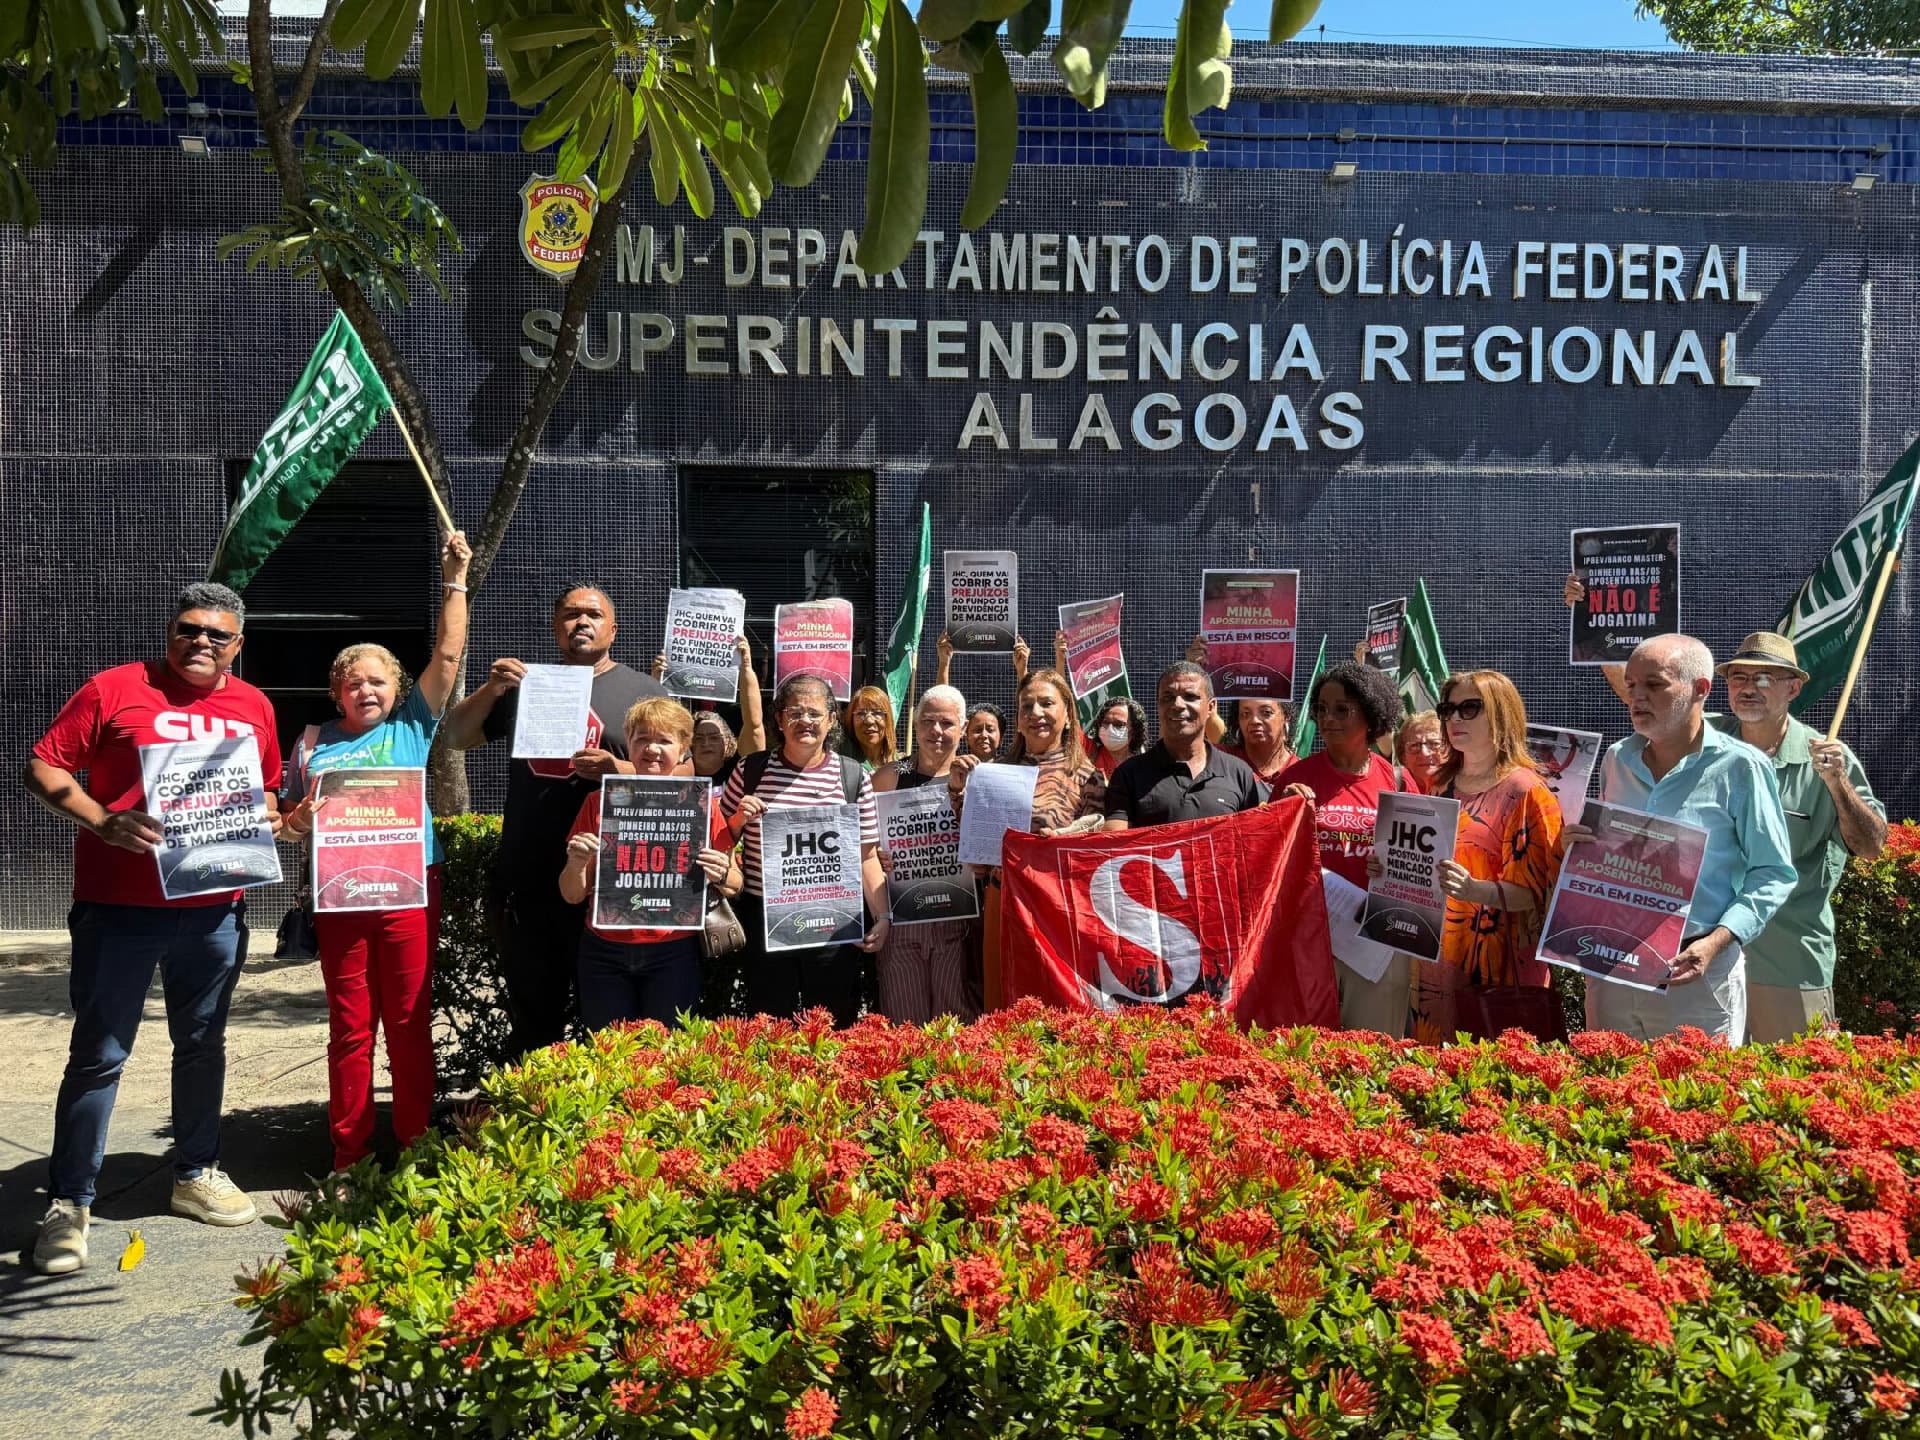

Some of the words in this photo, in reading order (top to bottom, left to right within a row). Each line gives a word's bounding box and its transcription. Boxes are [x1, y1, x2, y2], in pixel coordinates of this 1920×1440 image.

[533, 245, 584, 261] FEDERAL
[724, 226, 1171, 295] DEPATAMENTO
[1190, 236, 1258, 294] DE
[1280, 223, 1492, 298] POLÍCIA
[1514, 240, 1762, 302] FEDERAL
[519, 306, 1325, 383] SUPERINTENDÊNCIA
[1361, 324, 1762, 388] REGIONAL
[957, 391, 1365, 453] ALAGOAS
[311, 426, 336, 453] CUT
[1589, 567, 1627, 577] DINHEIRO
[1630, 567, 1661, 576] DAS/OS
[952, 578, 991, 587] COBRIR
[994, 578, 1008, 587] OS
[1589, 584, 1636, 613] NÃO
[1648, 583, 1661, 612] É
[695, 612, 720, 621] QUEM
[721, 616, 736, 624] VAI
[952, 613, 964, 621] DE
[1226, 606, 1272, 617] MINHA
[674, 618, 717, 631] COBRIR
[720, 623, 735, 633] OS
[796, 622, 833, 632] MINHA
[1209, 617, 1290, 626] APOSENTADORIA
[1588, 613, 1656, 627] JOGATINA
[783, 630, 847, 639] APOSENTADORIA
[1207, 631, 1234, 641] ESTÁ
[1236, 632, 1252, 641] EM
[1254, 631, 1290, 640] RISCO!
[672, 638, 686, 646] AO
[688, 639, 720, 649] FUNDO
[670, 653, 684, 663] DE
[154, 711, 255, 741] CUT
[156, 772, 184, 784] JHC,
[188, 768, 225, 781] QUEM
[228, 766, 249, 775] VAI
[158, 780, 223, 797] COBRIR
[227, 777, 251, 790] OS
[164, 814, 183, 824] AO
[187, 807, 234, 821] FUNDO
[238, 804, 255, 815] DE
[345, 806, 396, 817] MINHA
[665, 808, 697, 817] MASTER:
[909, 812, 938, 822] QUEM
[940, 810, 955, 818] VA
[1356, 806, 1377, 815] VEM
[325, 817, 416, 826] APOSENTADORIA
[619, 821, 657, 832] DINHEIRO
[660, 822, 691, 832] DAS/OS
[888, 821, 937, 837] COBRIR
[939, 819, 959, 831] OS
[166, 838, 187, 849] DE
[324, 833, 355, 844] ESTÁ
[358, 834, 375, 843] EM
[379, 832, 417, 841] RISCO!
[618, 832, 691, 842] APOSENTADAS/OS
[781, 831, 840, 857] JHC
[1331, 831, 1375, 845] SINDPR
[1387, 821, 1437, 853] JHC
[892, 851, 907, 860] AO
[909, 845, 944, 858] FUNDO
[1344, 841, 1375, 857] LUT
[1388, 848, 1420, 862] APOSTOU
[1422, 855, 1434, 864] NO
[616, 840, 666, 873] NÃO
[677, 841, 690, 873] É
[782, 856, 825, 866] APOSTOU
[827, 855, 841, 864] NO
[782, 863, 841, 877] MERCADO
[1387, 858, 1433, 876] MERCADO
[1603, 852, 1662, 880] MINHA
[615, 872, 683, 889] JOGATINA
[782, 874, 841, 887] FINANCEIRO
[894, 871, 910, 881] DE
[1576, 859, 1684, 896] APOSENTADORIA
[780, 888, 798, 896] COM
[800, 887, 807, 895] O
[808, 885, 845, 894] DINHEIRO
[1569, 880, 1605, 897] ESTÁ
[1608, 887, 1631, 902] EM
[768, 896, 797, 905] DOS/AS
[1576, 934, 1640, 966] SINTEAL
